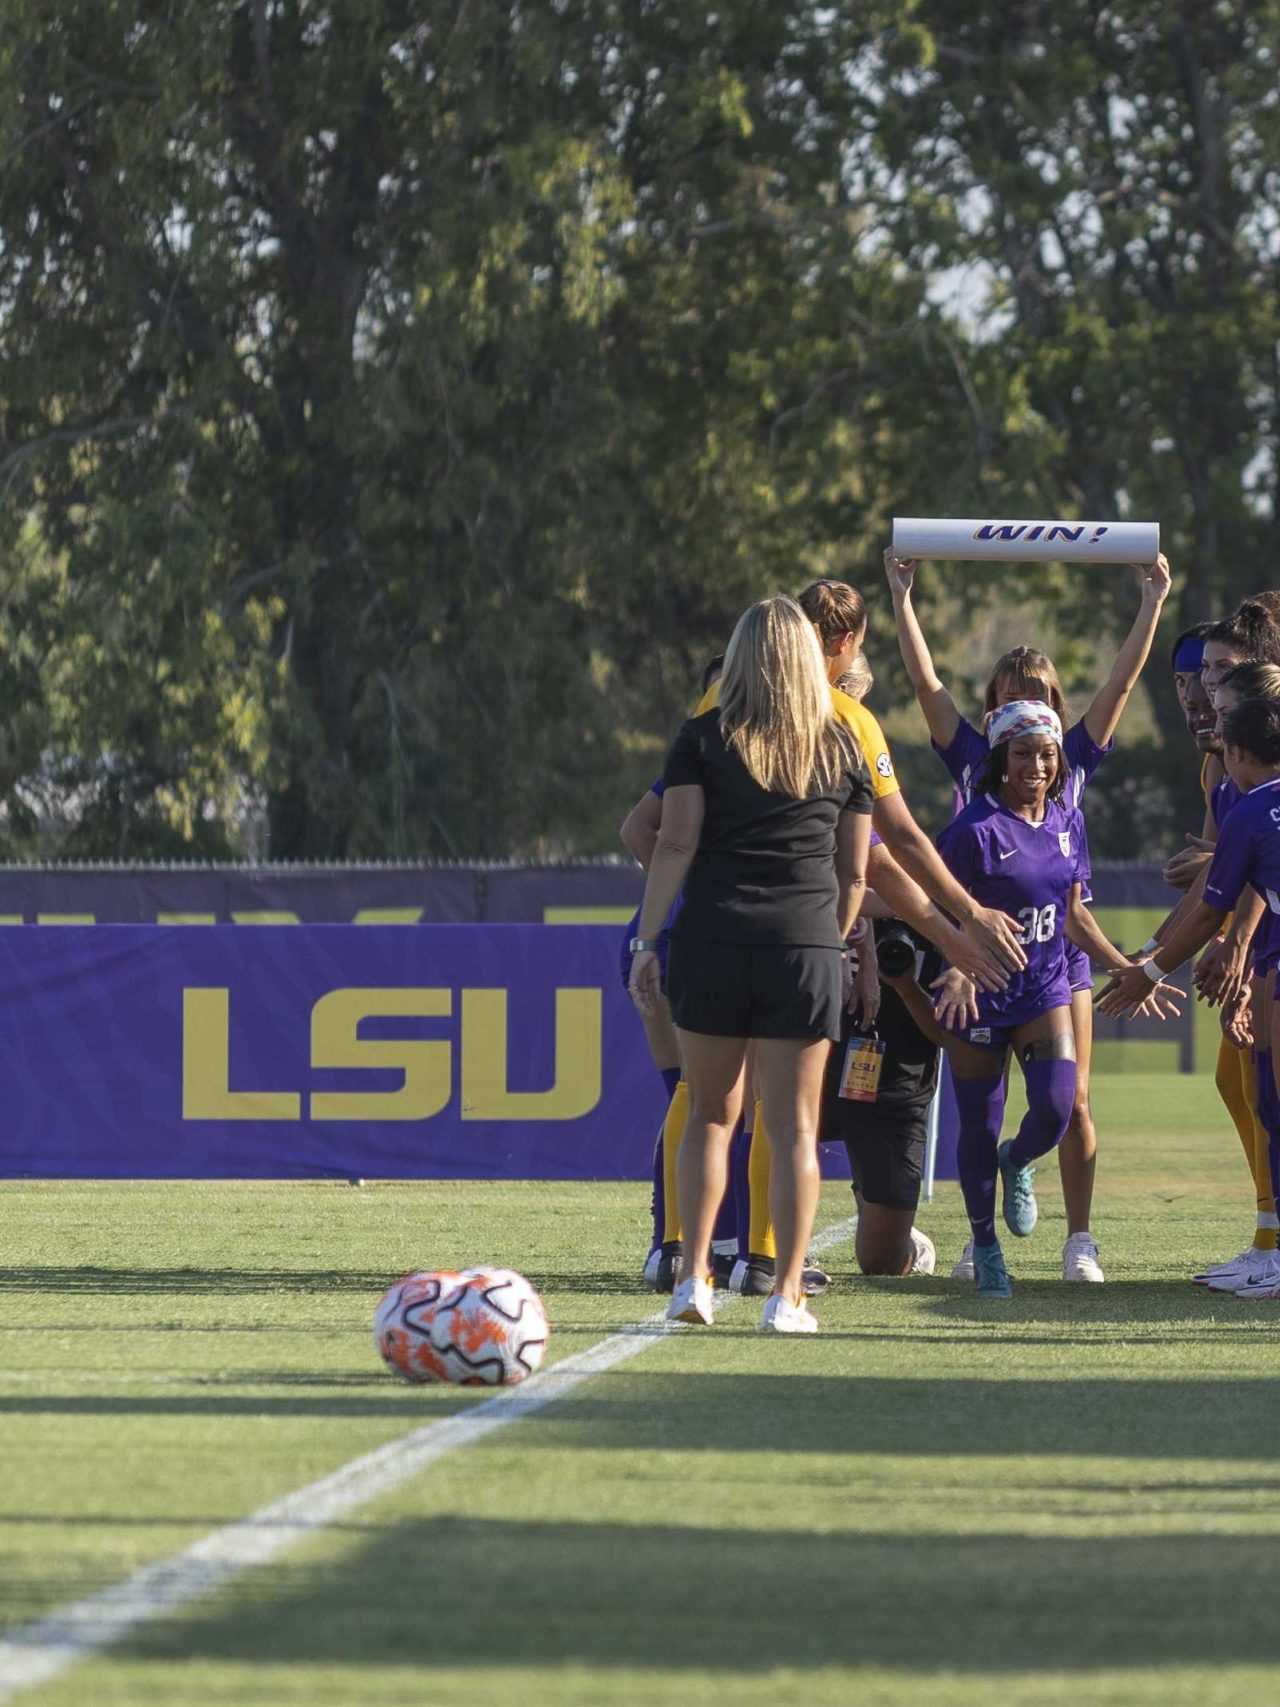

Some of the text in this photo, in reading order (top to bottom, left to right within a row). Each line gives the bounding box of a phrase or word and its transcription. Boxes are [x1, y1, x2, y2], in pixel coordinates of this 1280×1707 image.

[973, 525, 1108, 543] WIN!
[1015, 904, 1057, 945] 38
[182, 987, 602, 1121] LSU
